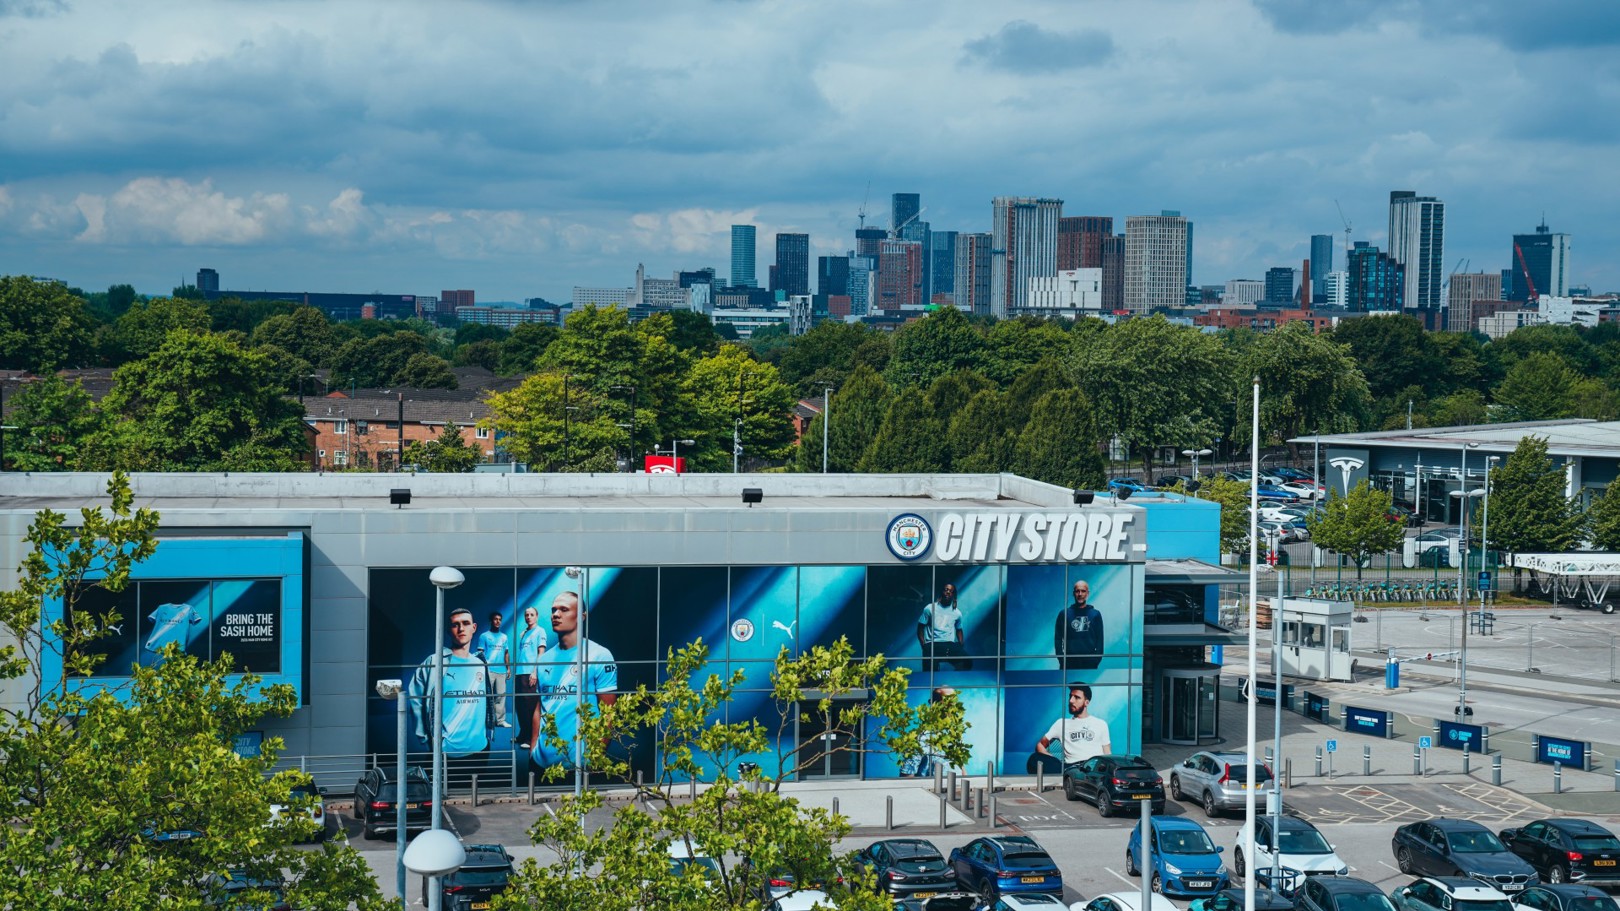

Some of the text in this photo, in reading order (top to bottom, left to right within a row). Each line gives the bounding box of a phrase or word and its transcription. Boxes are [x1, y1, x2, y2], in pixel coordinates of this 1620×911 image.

[893, 518, 926, 531] MANCHESTER
[936, 513, 1133, 561] CITY STORE
[226, 613, 273, 625] BRING THE
[220, 625, 273, 637] SASH HOME
[1071, 731, 1086, 740] CITY
[236, 745, 256, 755] STORE
